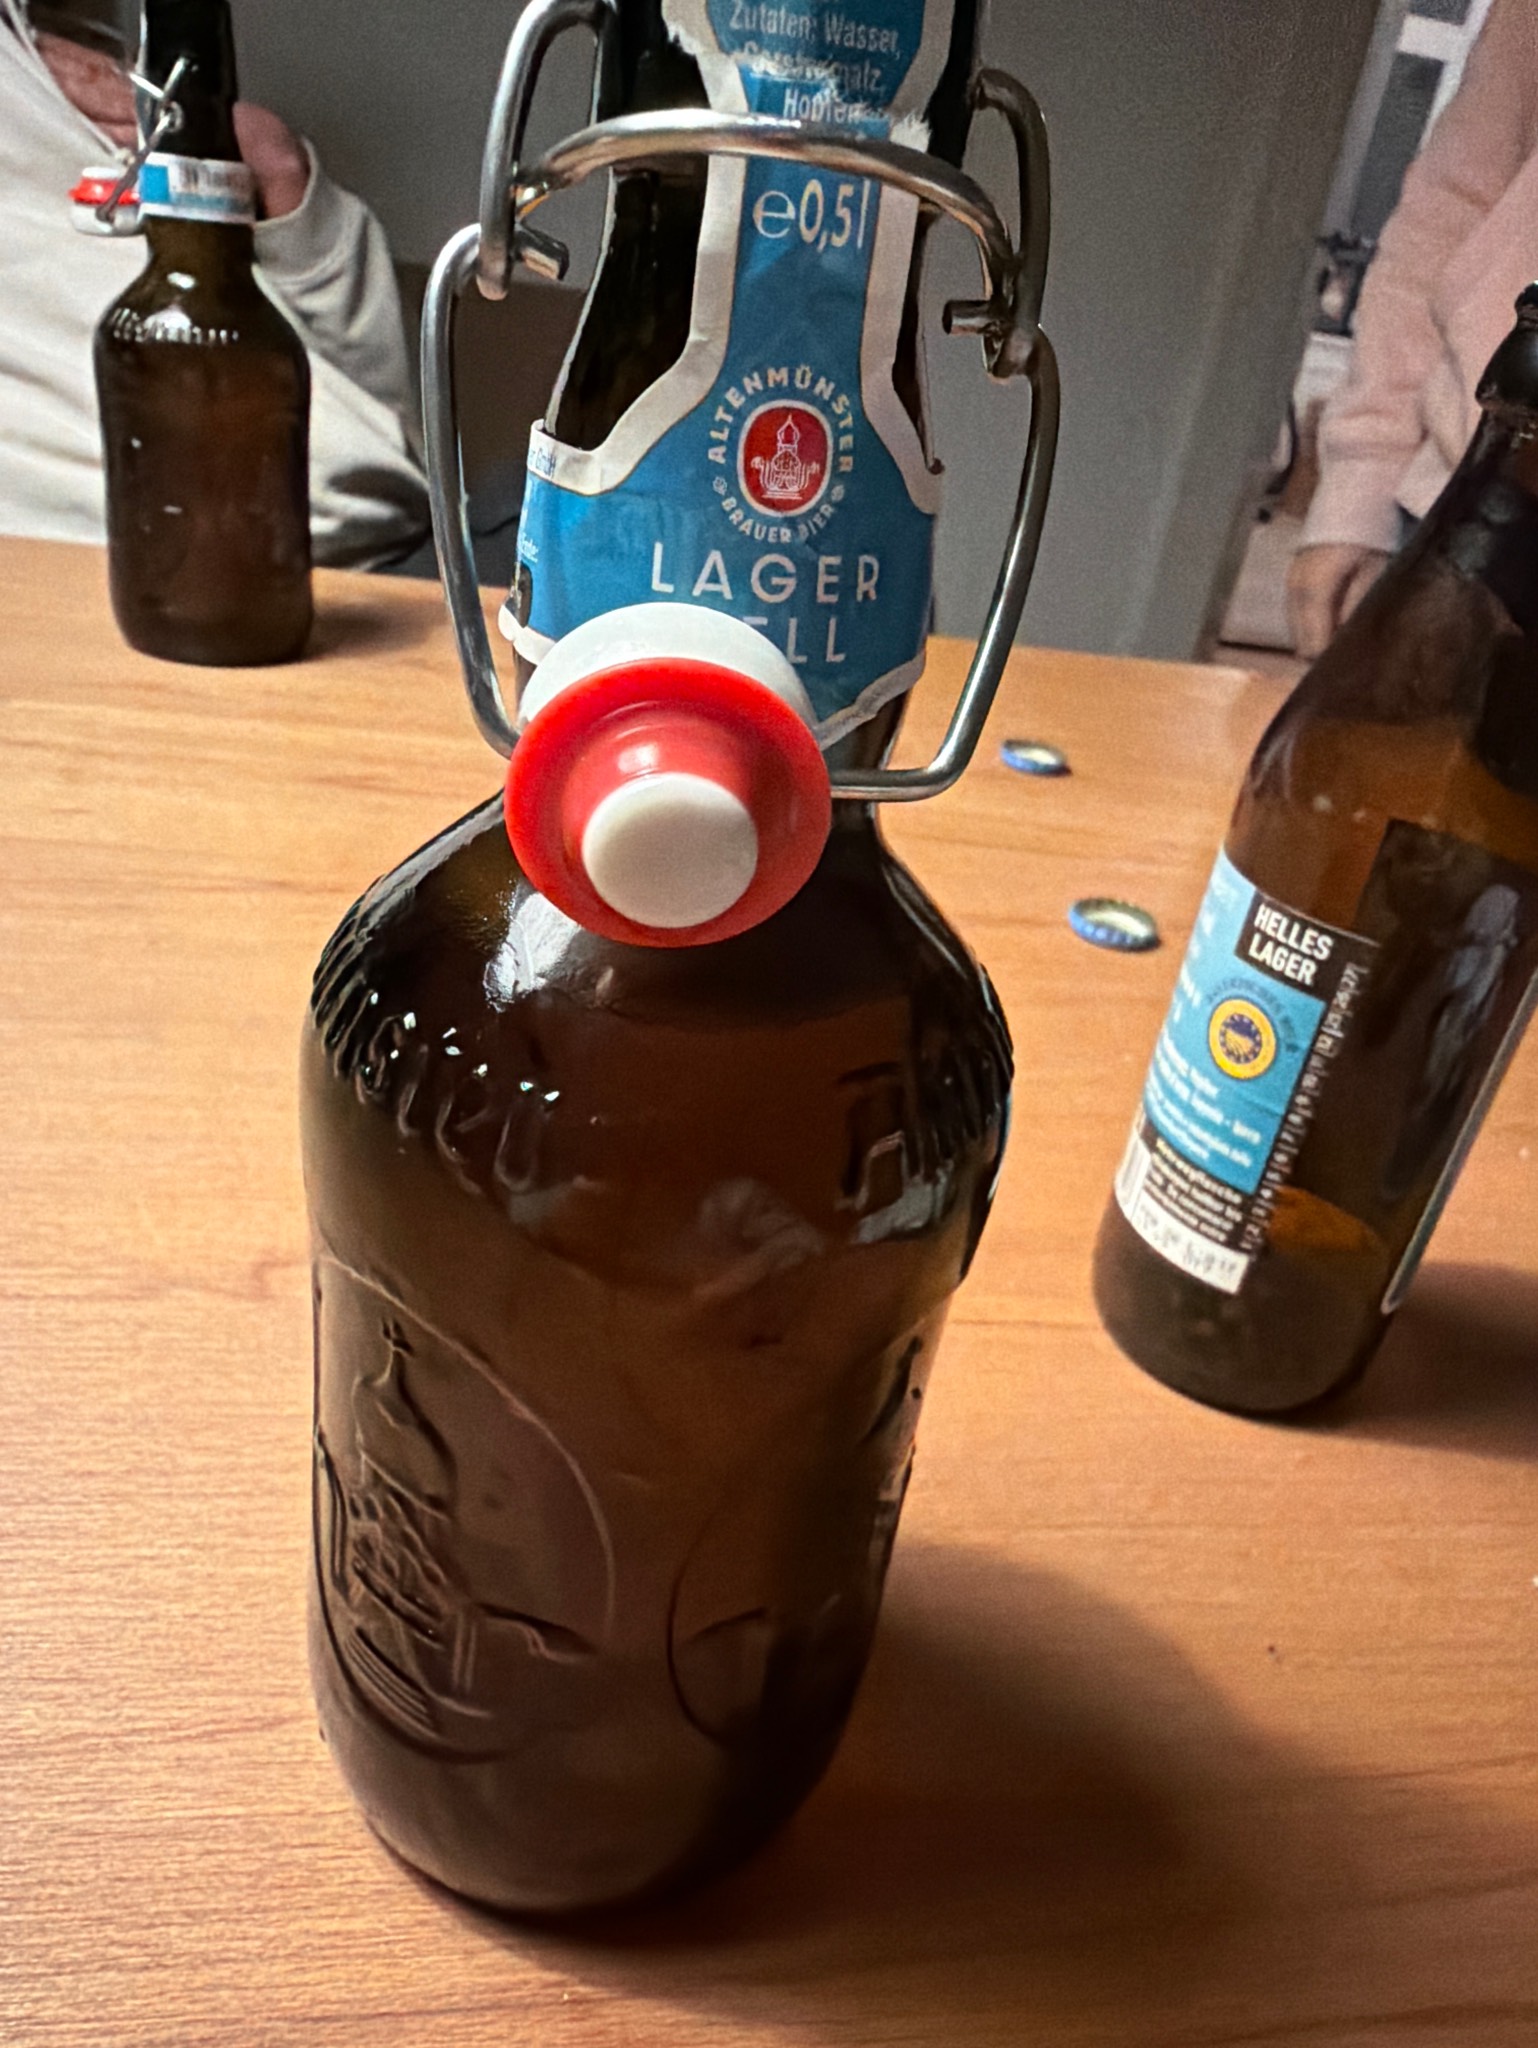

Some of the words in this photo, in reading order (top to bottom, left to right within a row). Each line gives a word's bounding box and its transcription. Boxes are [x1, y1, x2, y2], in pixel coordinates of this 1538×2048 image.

[824, 11, 900, 60] Wasser,
[708, 364, 853, 472] ALTENMÜNSTER
[722, 497, 791, 543] BRAUER
[798, 503, 835, 539] BIER
[651, 541, 880, 604] LAGER
[1247, 933, 1318, 986] LAGER
[1253, 903, 1333, 961] HELLES
